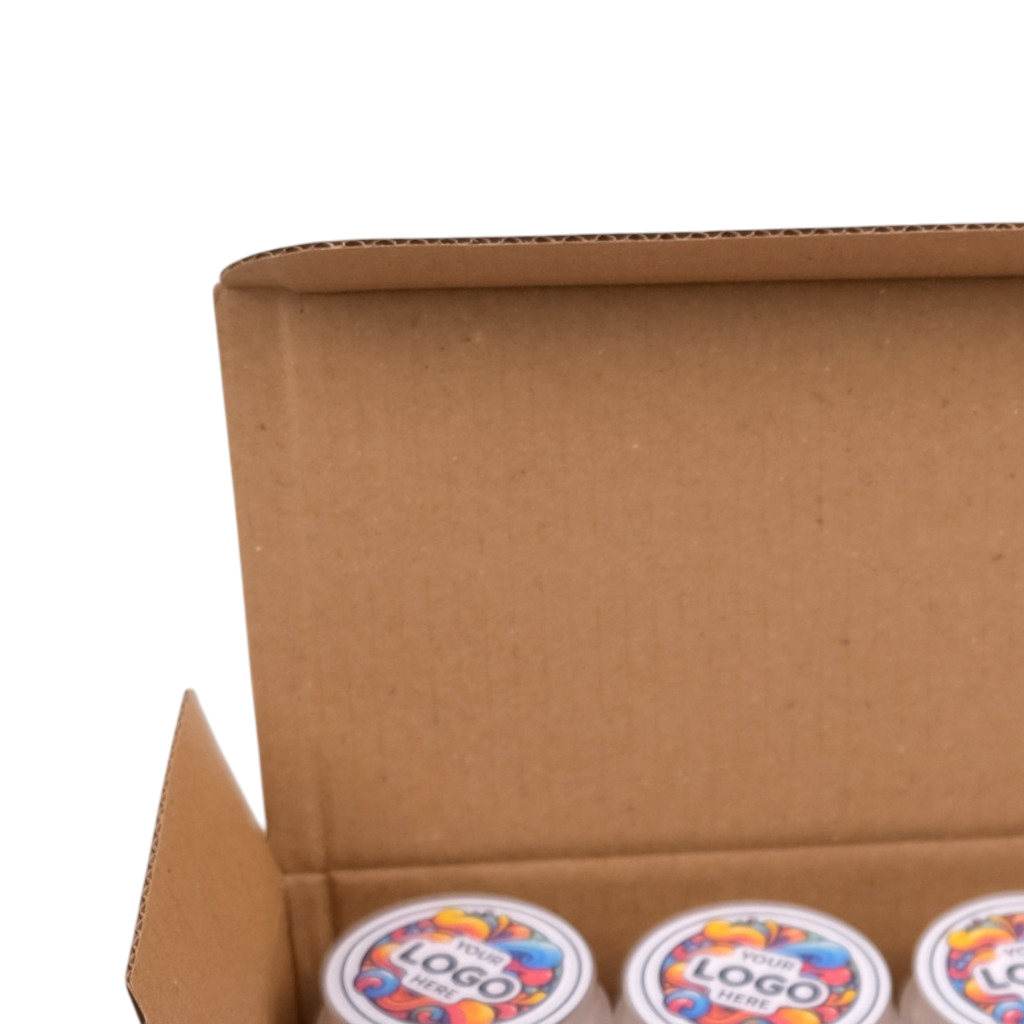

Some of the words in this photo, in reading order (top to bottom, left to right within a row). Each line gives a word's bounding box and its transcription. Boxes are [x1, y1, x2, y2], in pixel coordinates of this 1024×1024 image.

[456, 940, 507, 967] YOUR
[741, 951, 795, 972] YOUR
[399, 942, 515, 998] LOGO
[693, 957, 821, 1003] LOGO
[411, 975, 457, 1000] HERE
[717, 989, 770, 1010] HERE
